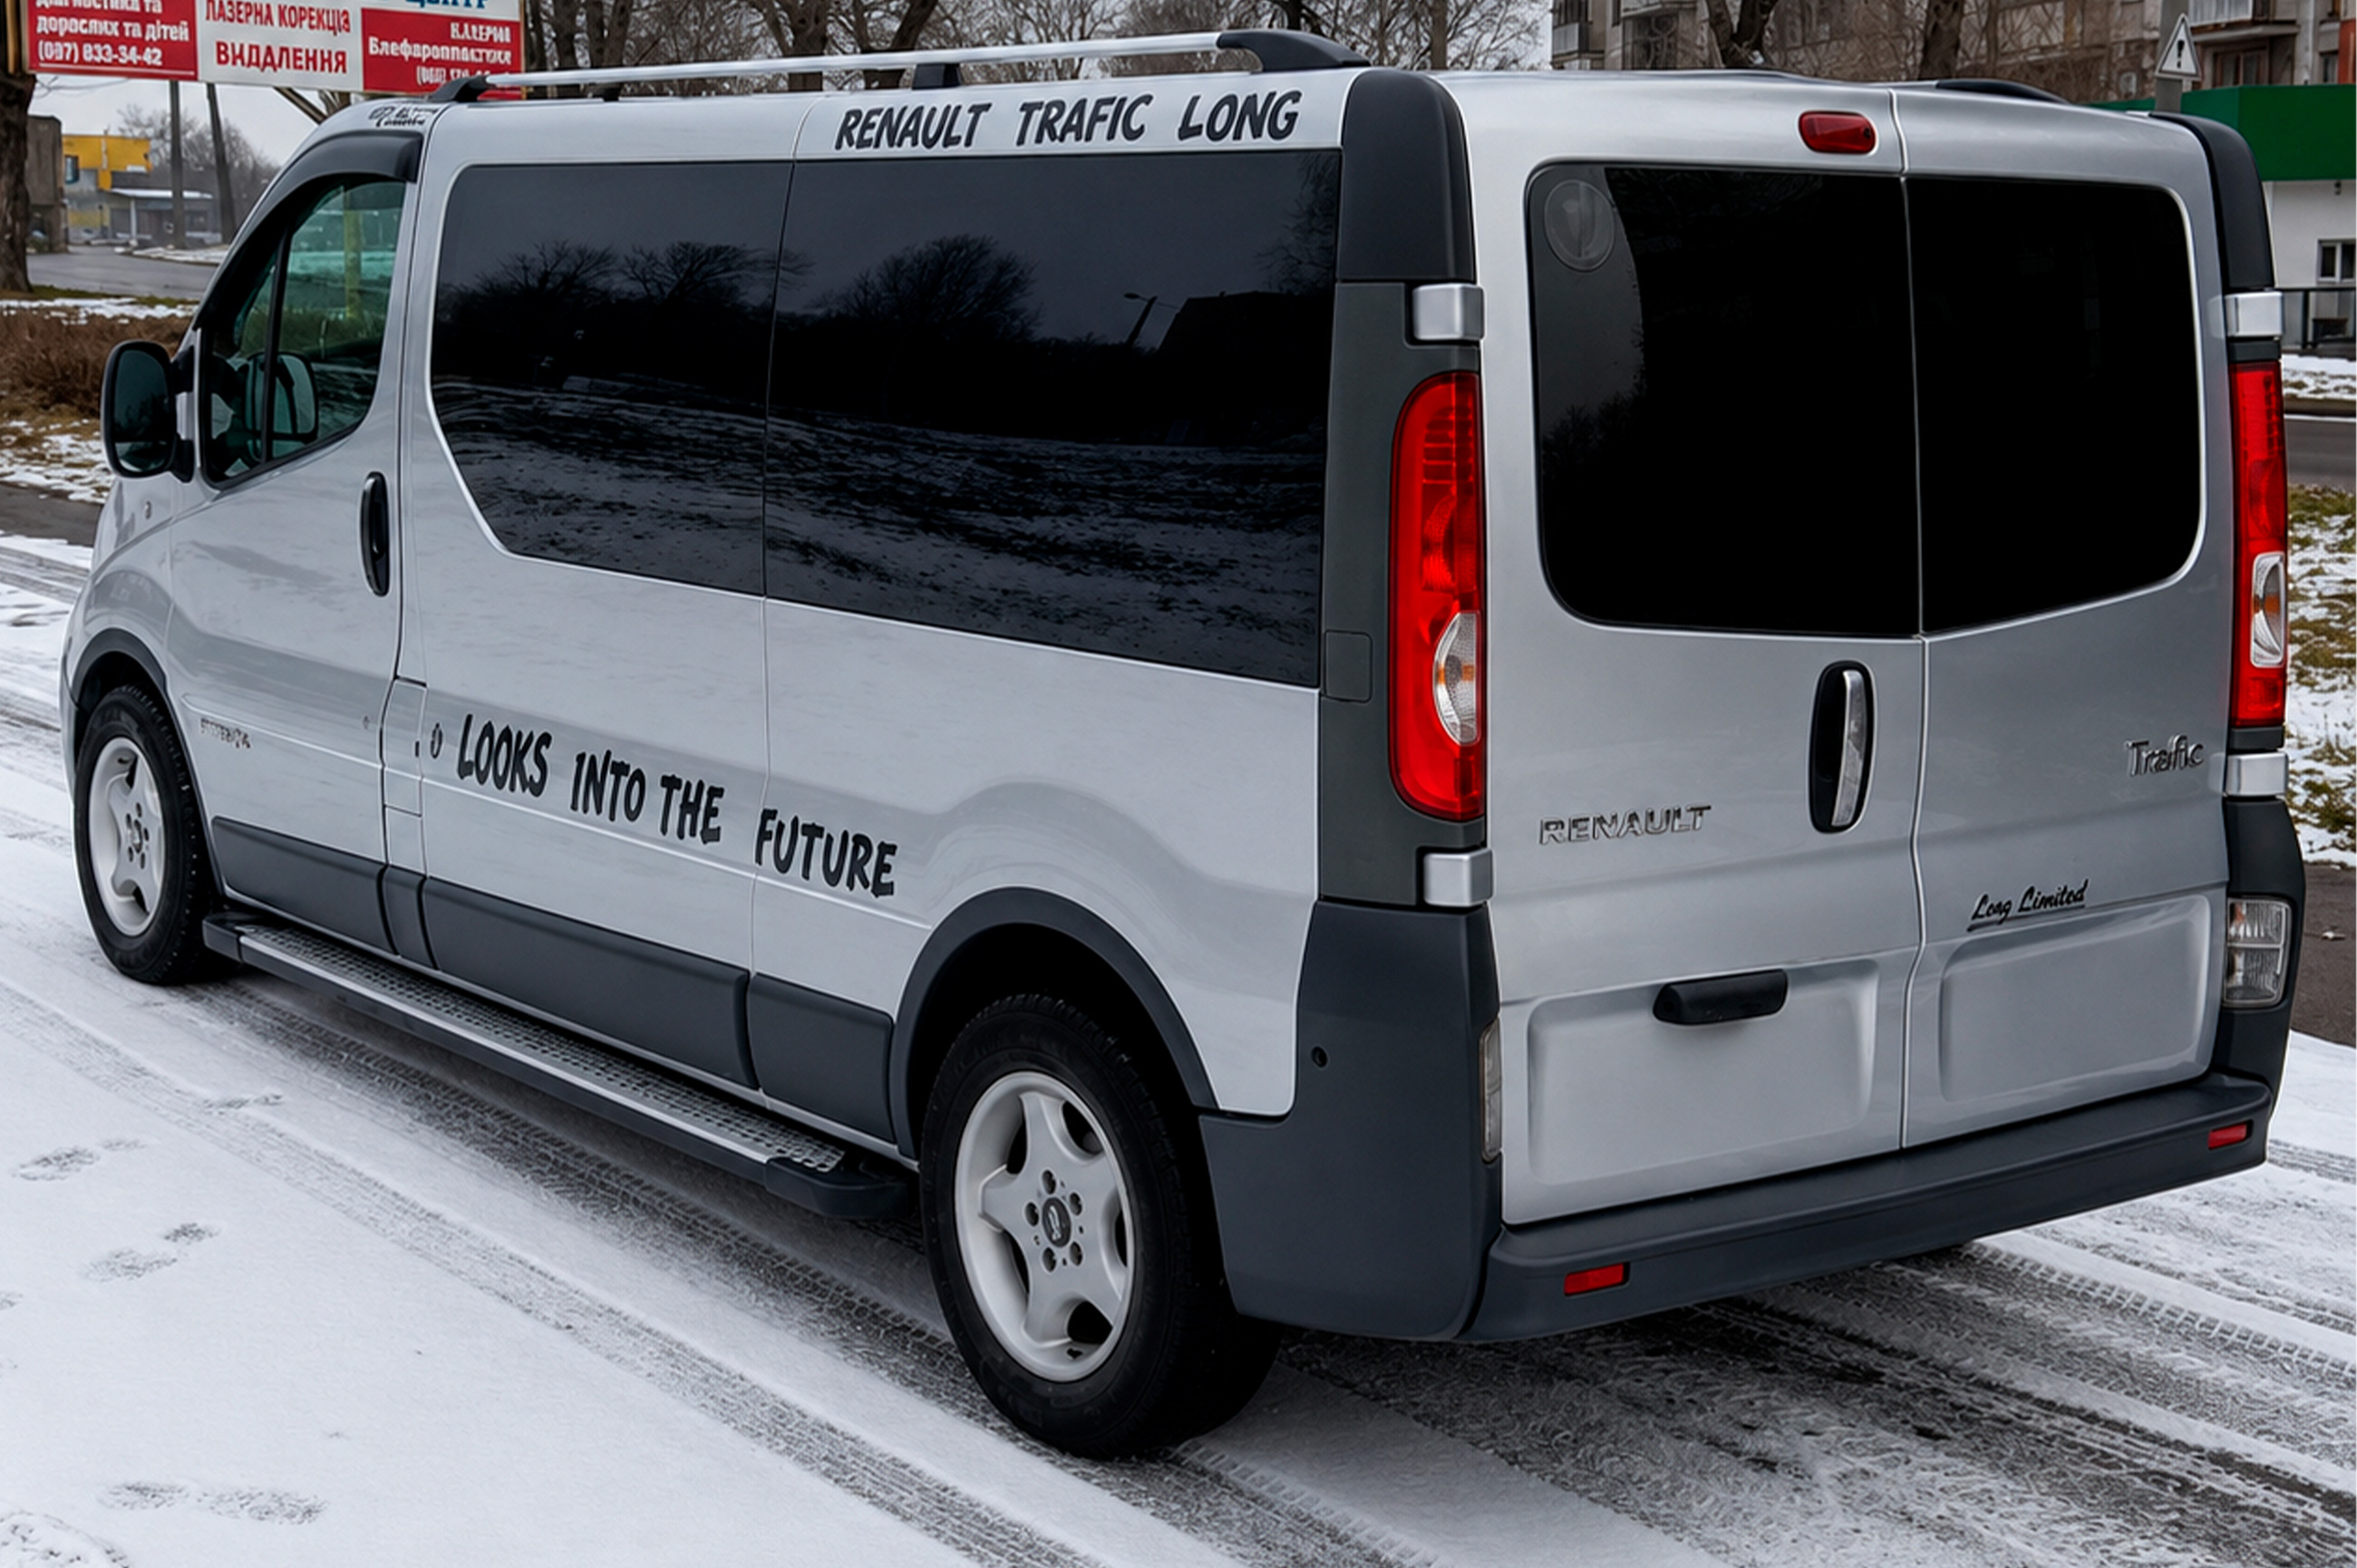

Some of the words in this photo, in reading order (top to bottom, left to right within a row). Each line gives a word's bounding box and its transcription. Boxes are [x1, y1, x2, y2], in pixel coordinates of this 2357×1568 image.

[123, 22, 141, 38] та
[145, 21, 189, 42] дітей
[216, 41, 347, 73] ВИДАЛЕННЯ
[834, 102, 993, 150] RENAULT
[1016, 94, 1153, 147] TRAFIC
[1178, 91, 1303, 142] LONG
[2126, 733, 2204, 777] Trafic
[457, 713, 553, 798] LOOKS
[660, 774, 725, 845] THE
[755, 808, 897, 898] FUTURE
[1539, 805, 1712, 846] RENAULT
[1971, 894, 2013, 925] Long
[2018, 878, 2089, 913] Limited
